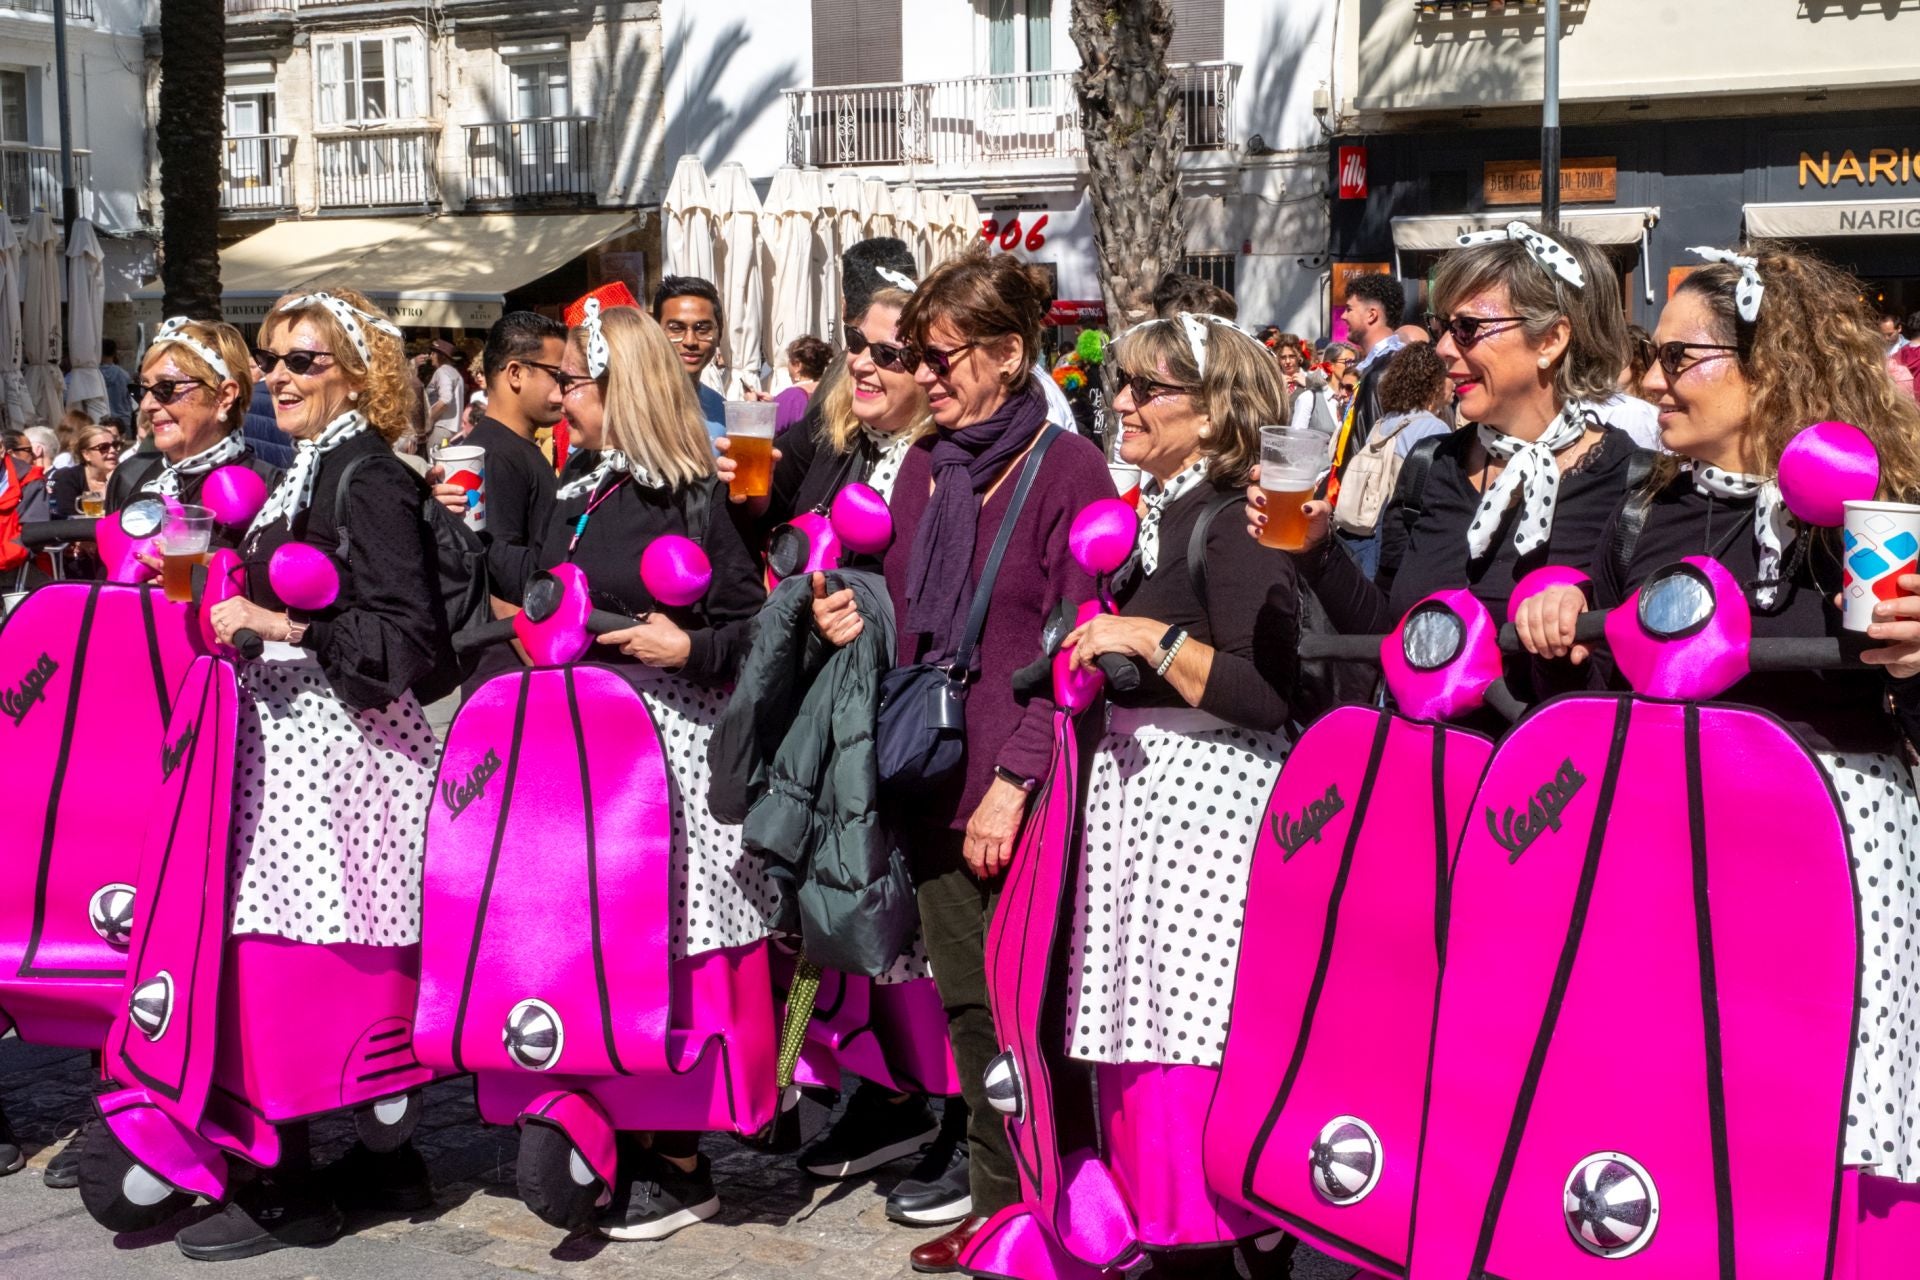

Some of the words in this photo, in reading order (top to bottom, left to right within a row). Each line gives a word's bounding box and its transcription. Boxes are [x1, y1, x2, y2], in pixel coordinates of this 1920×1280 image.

[1341, 154, 1366, 194] illy
[1490, 173, 1515, 192] BEST
[1519, 172, 1543, 191] GELA
[1575, 171, 1603, 189] TOWN
[387, 306, 423, 317] ENTRO
[0, 651, 59, 728] Vespa
[442, 747, 503, 822] Vespa
[1485, 756, 1587, 865] Vespa
[1271, 783, 1345, 864] Vespa
